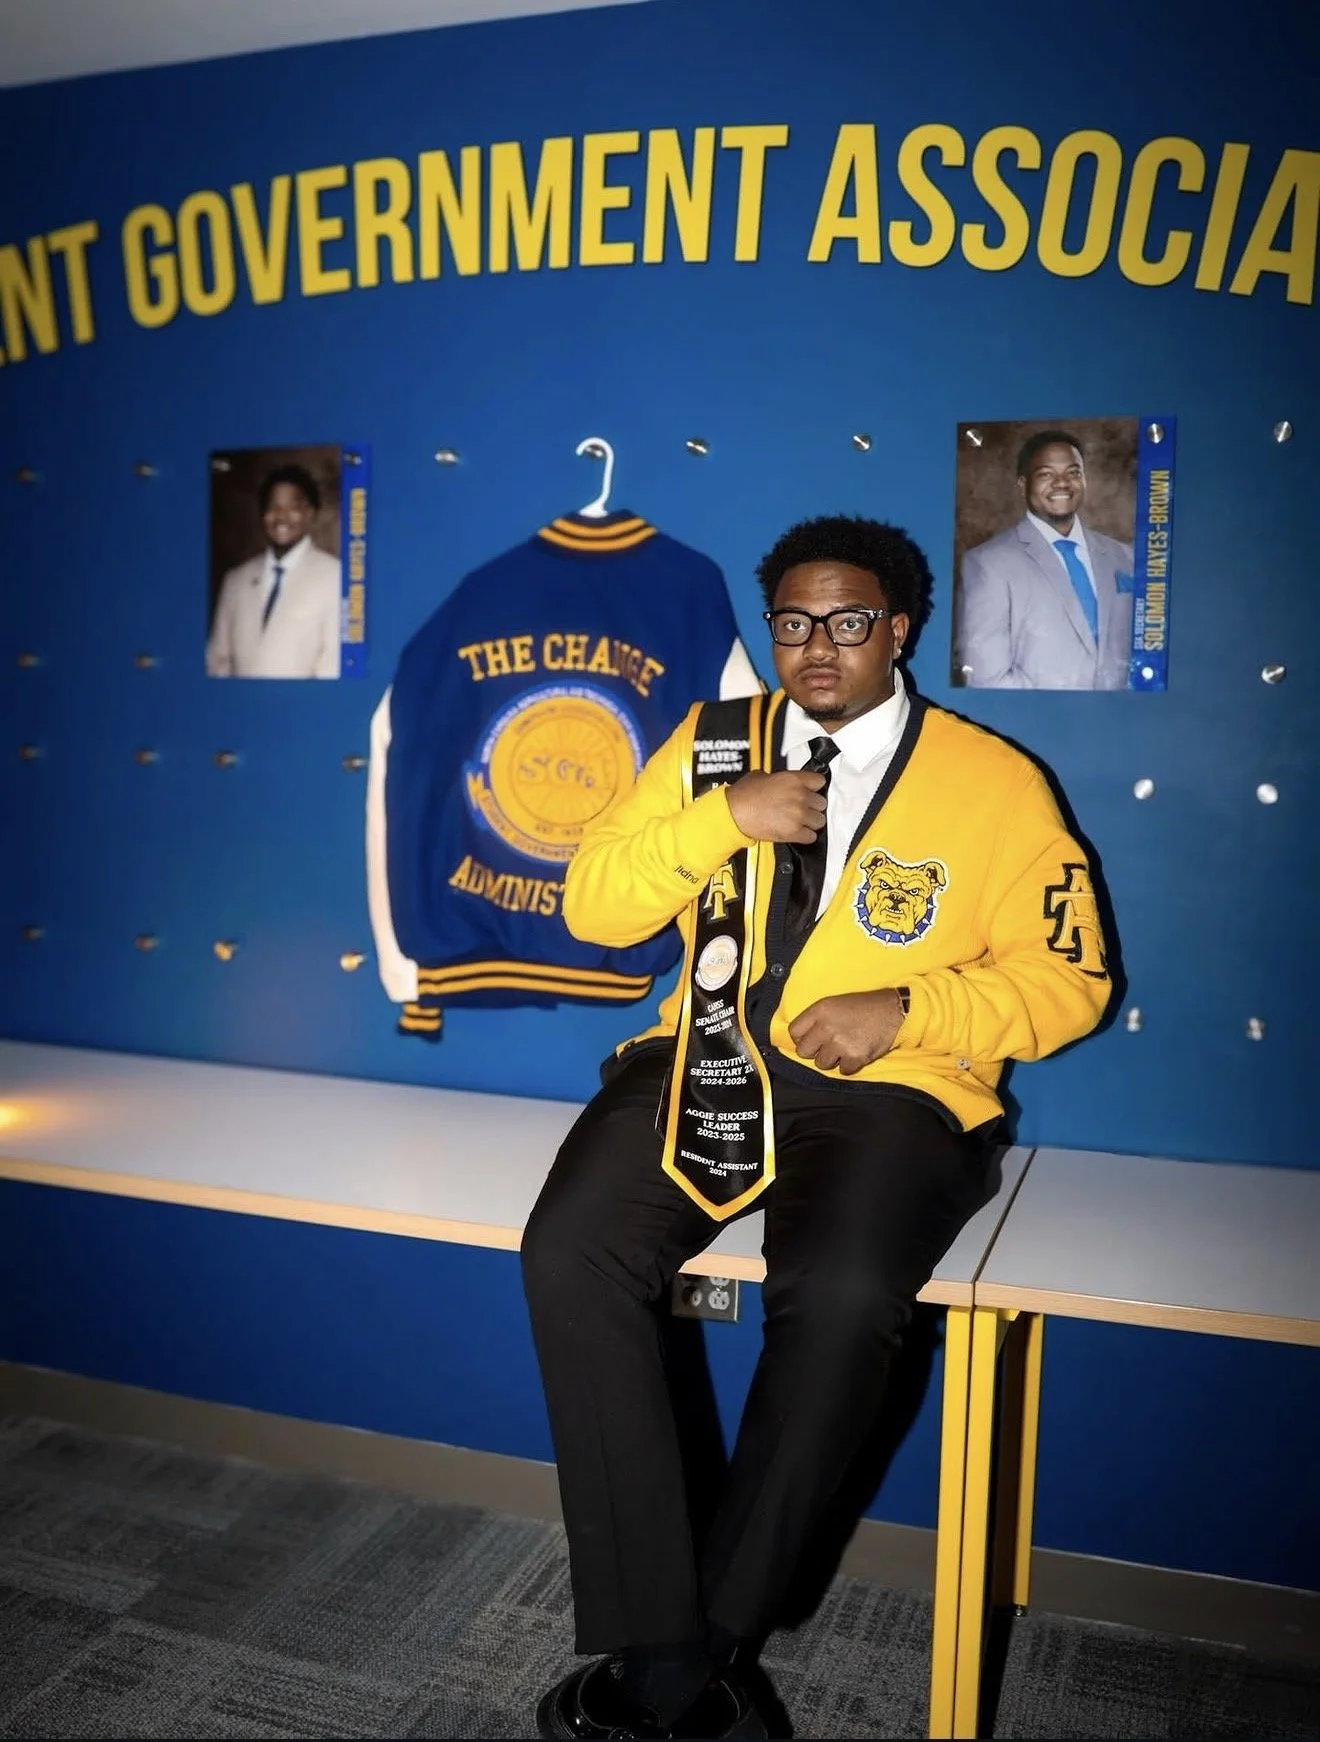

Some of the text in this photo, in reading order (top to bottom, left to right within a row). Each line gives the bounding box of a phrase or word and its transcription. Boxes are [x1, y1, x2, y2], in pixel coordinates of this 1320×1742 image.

[0, 124, 1320, 366] NT GOVERNMENT ASSOCIA
[1144, 469, 1170, 652] SOLOMON HAYES-BROWN
[458, 633, 665, 697] THE CHANGE
[693, 739, 750, 752] SOLOMON
[696, 762, 744, 775] BROWN
[448, 854, 565, 916] ADMINIS
[695, 1005, 735, 1027] SENATE CHAIR
[704, 1018, 733, 1036] 2023-2024
[700, 1054, 748, 1068] EXECUTIVE
[690, 1063, 755, 1077] SECRETARY 2X
[700, 1076, 747, 1086] 2024-2026
[685, 1107, 759, 1121] AGGIE SUCCESS
[703, 1120, 741, 1132] LEADER
[696, 1127, 746, 1142] 2023-2025
[681, 1149, 759, 1171] RESIDENT ASSISTANT
[708, 1167, 728, 1178] 2024
